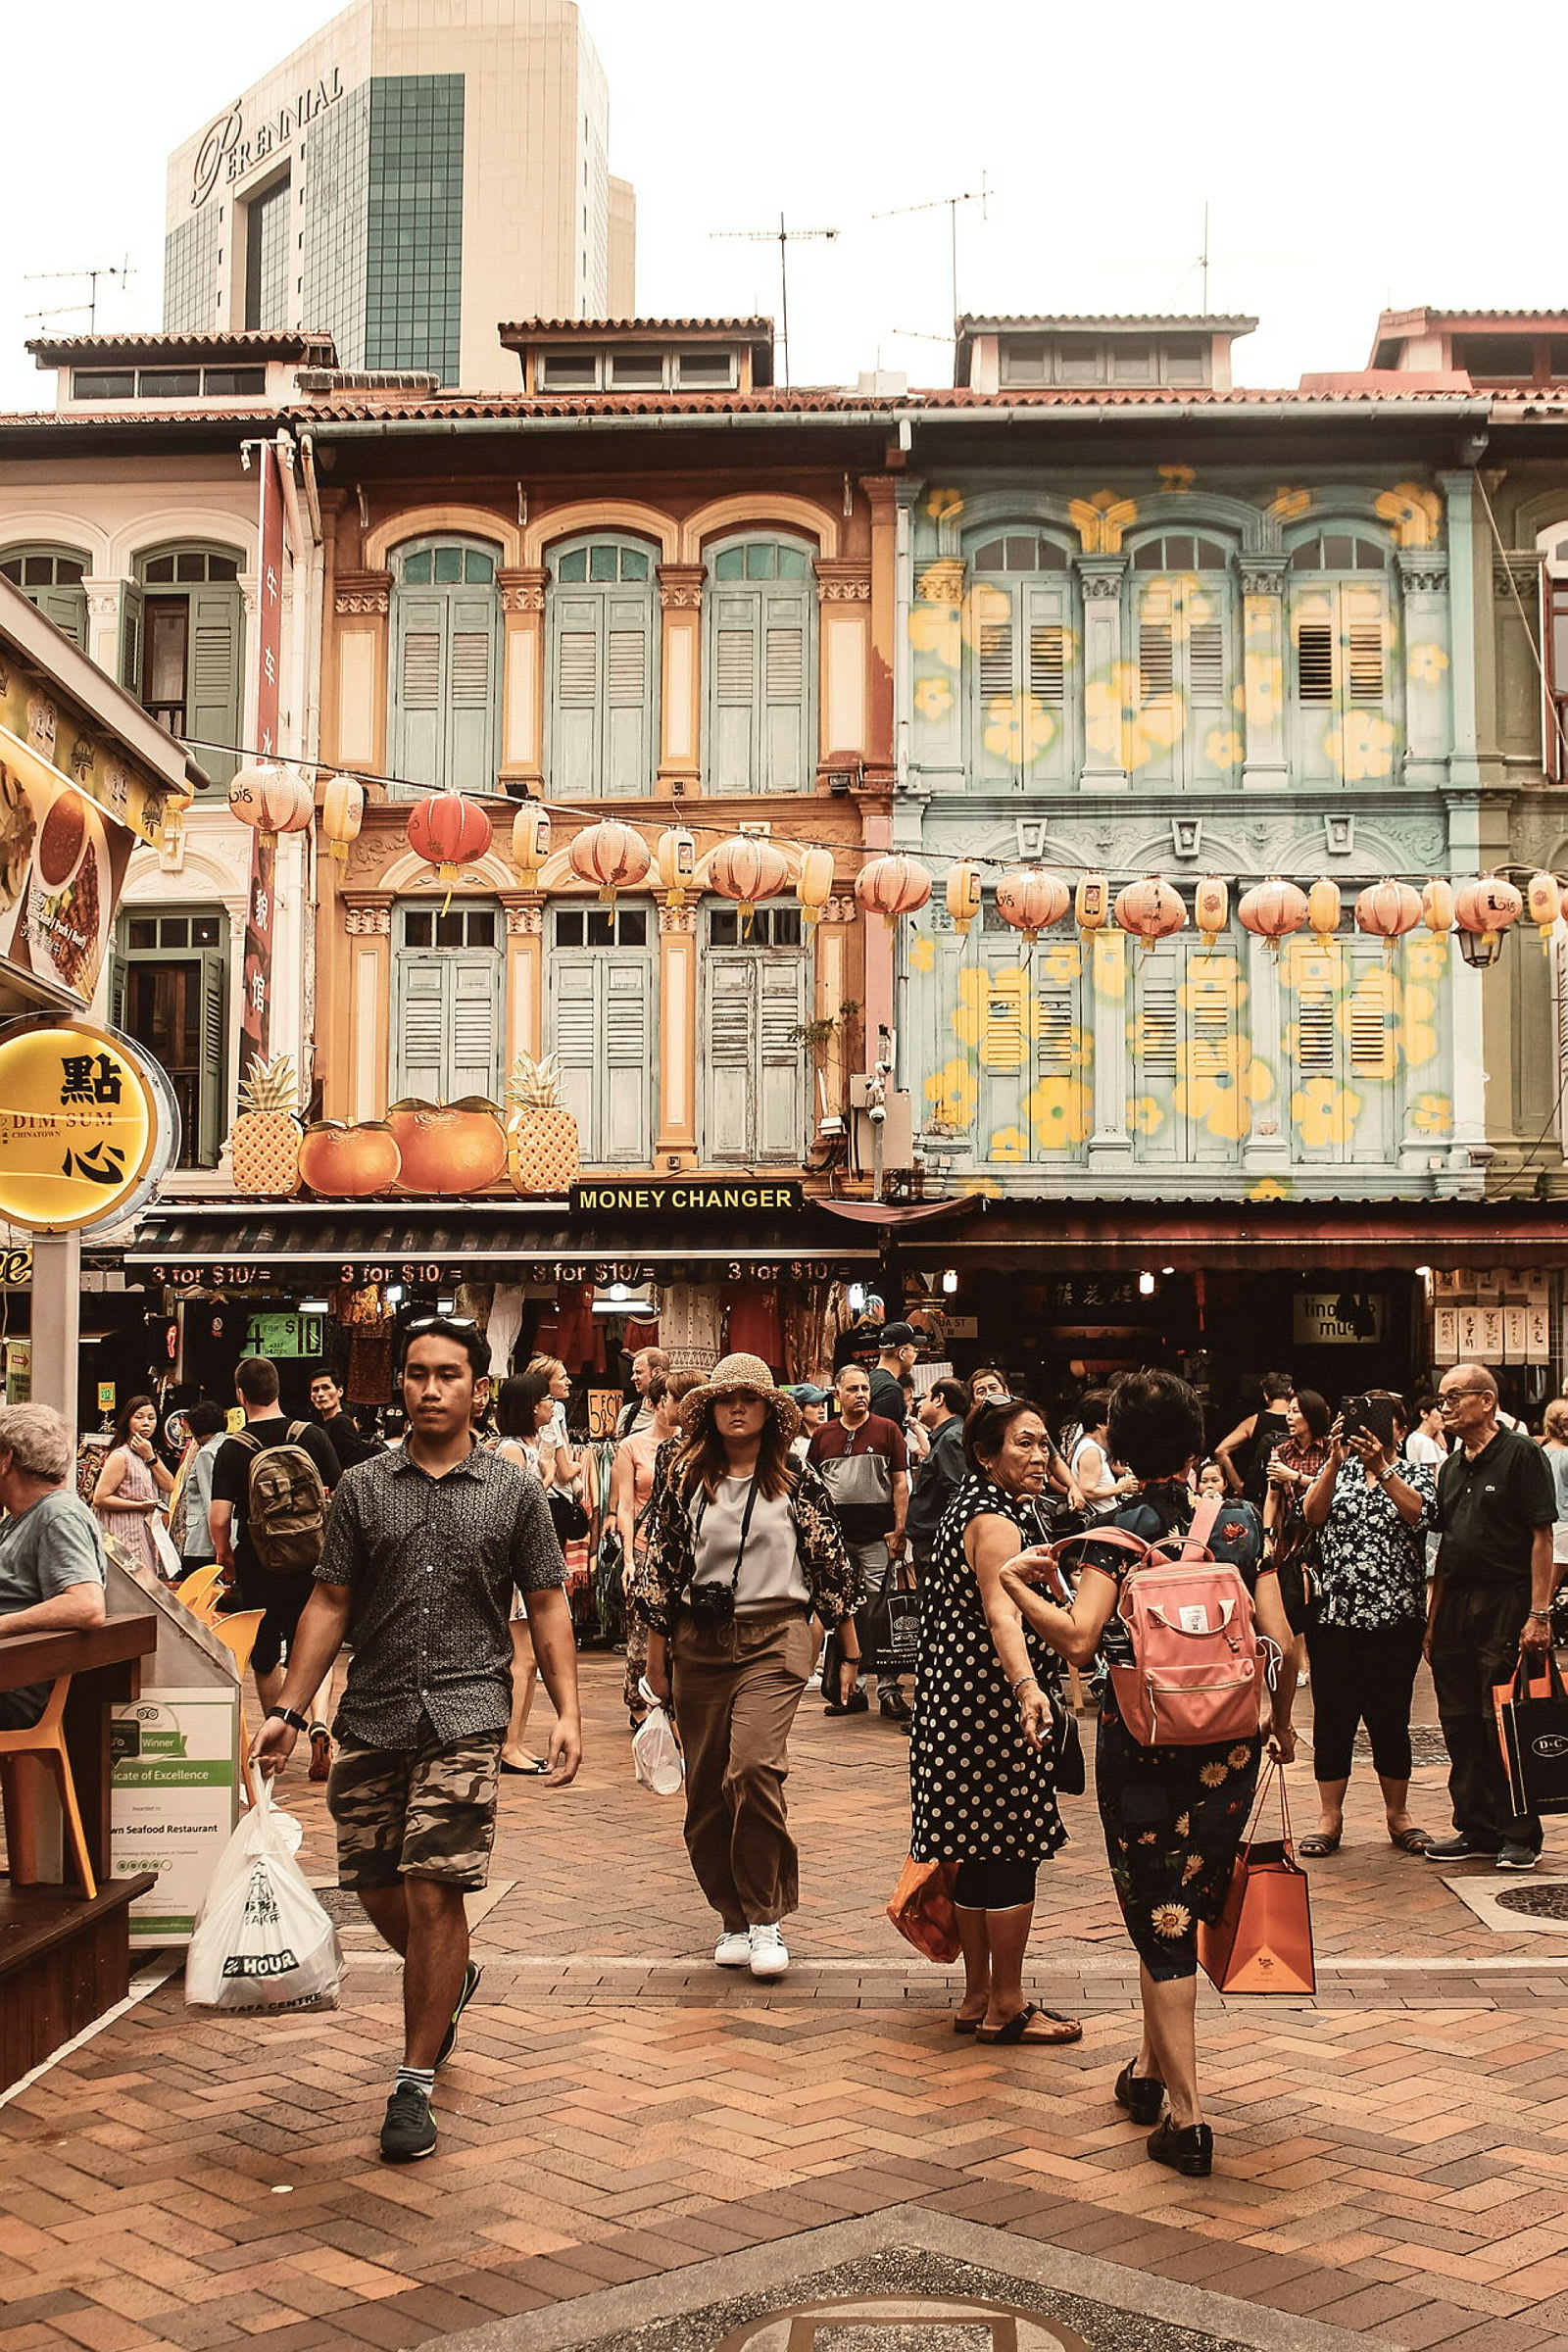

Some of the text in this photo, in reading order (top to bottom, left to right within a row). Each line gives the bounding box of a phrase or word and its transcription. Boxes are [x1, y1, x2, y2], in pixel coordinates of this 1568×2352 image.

[13, 1111, 113, 1129] DIM SUM
[579, 1189, 793, 1208] MONEY CHANGER
[340, 1263, 354, 1283] 3
[362, 1263, 394, 1283] for
[554, 1262, 586, 1282] for
[728, 1261, 742, 1280] 3
[589, 1395, 601, 1434] 5
[142, 1739, 175, 1749] Winner
[140, 1770, 153, 1781] of
[154, 1769, 210, 1781] Excellence
[126, 1825, 165, 1835] Seafood
[167, 1824, 219, 1834] Restaurant
[243, 1952, 296, 1974] HOUR
[268, 1991, 322, 2011] CENTRE
